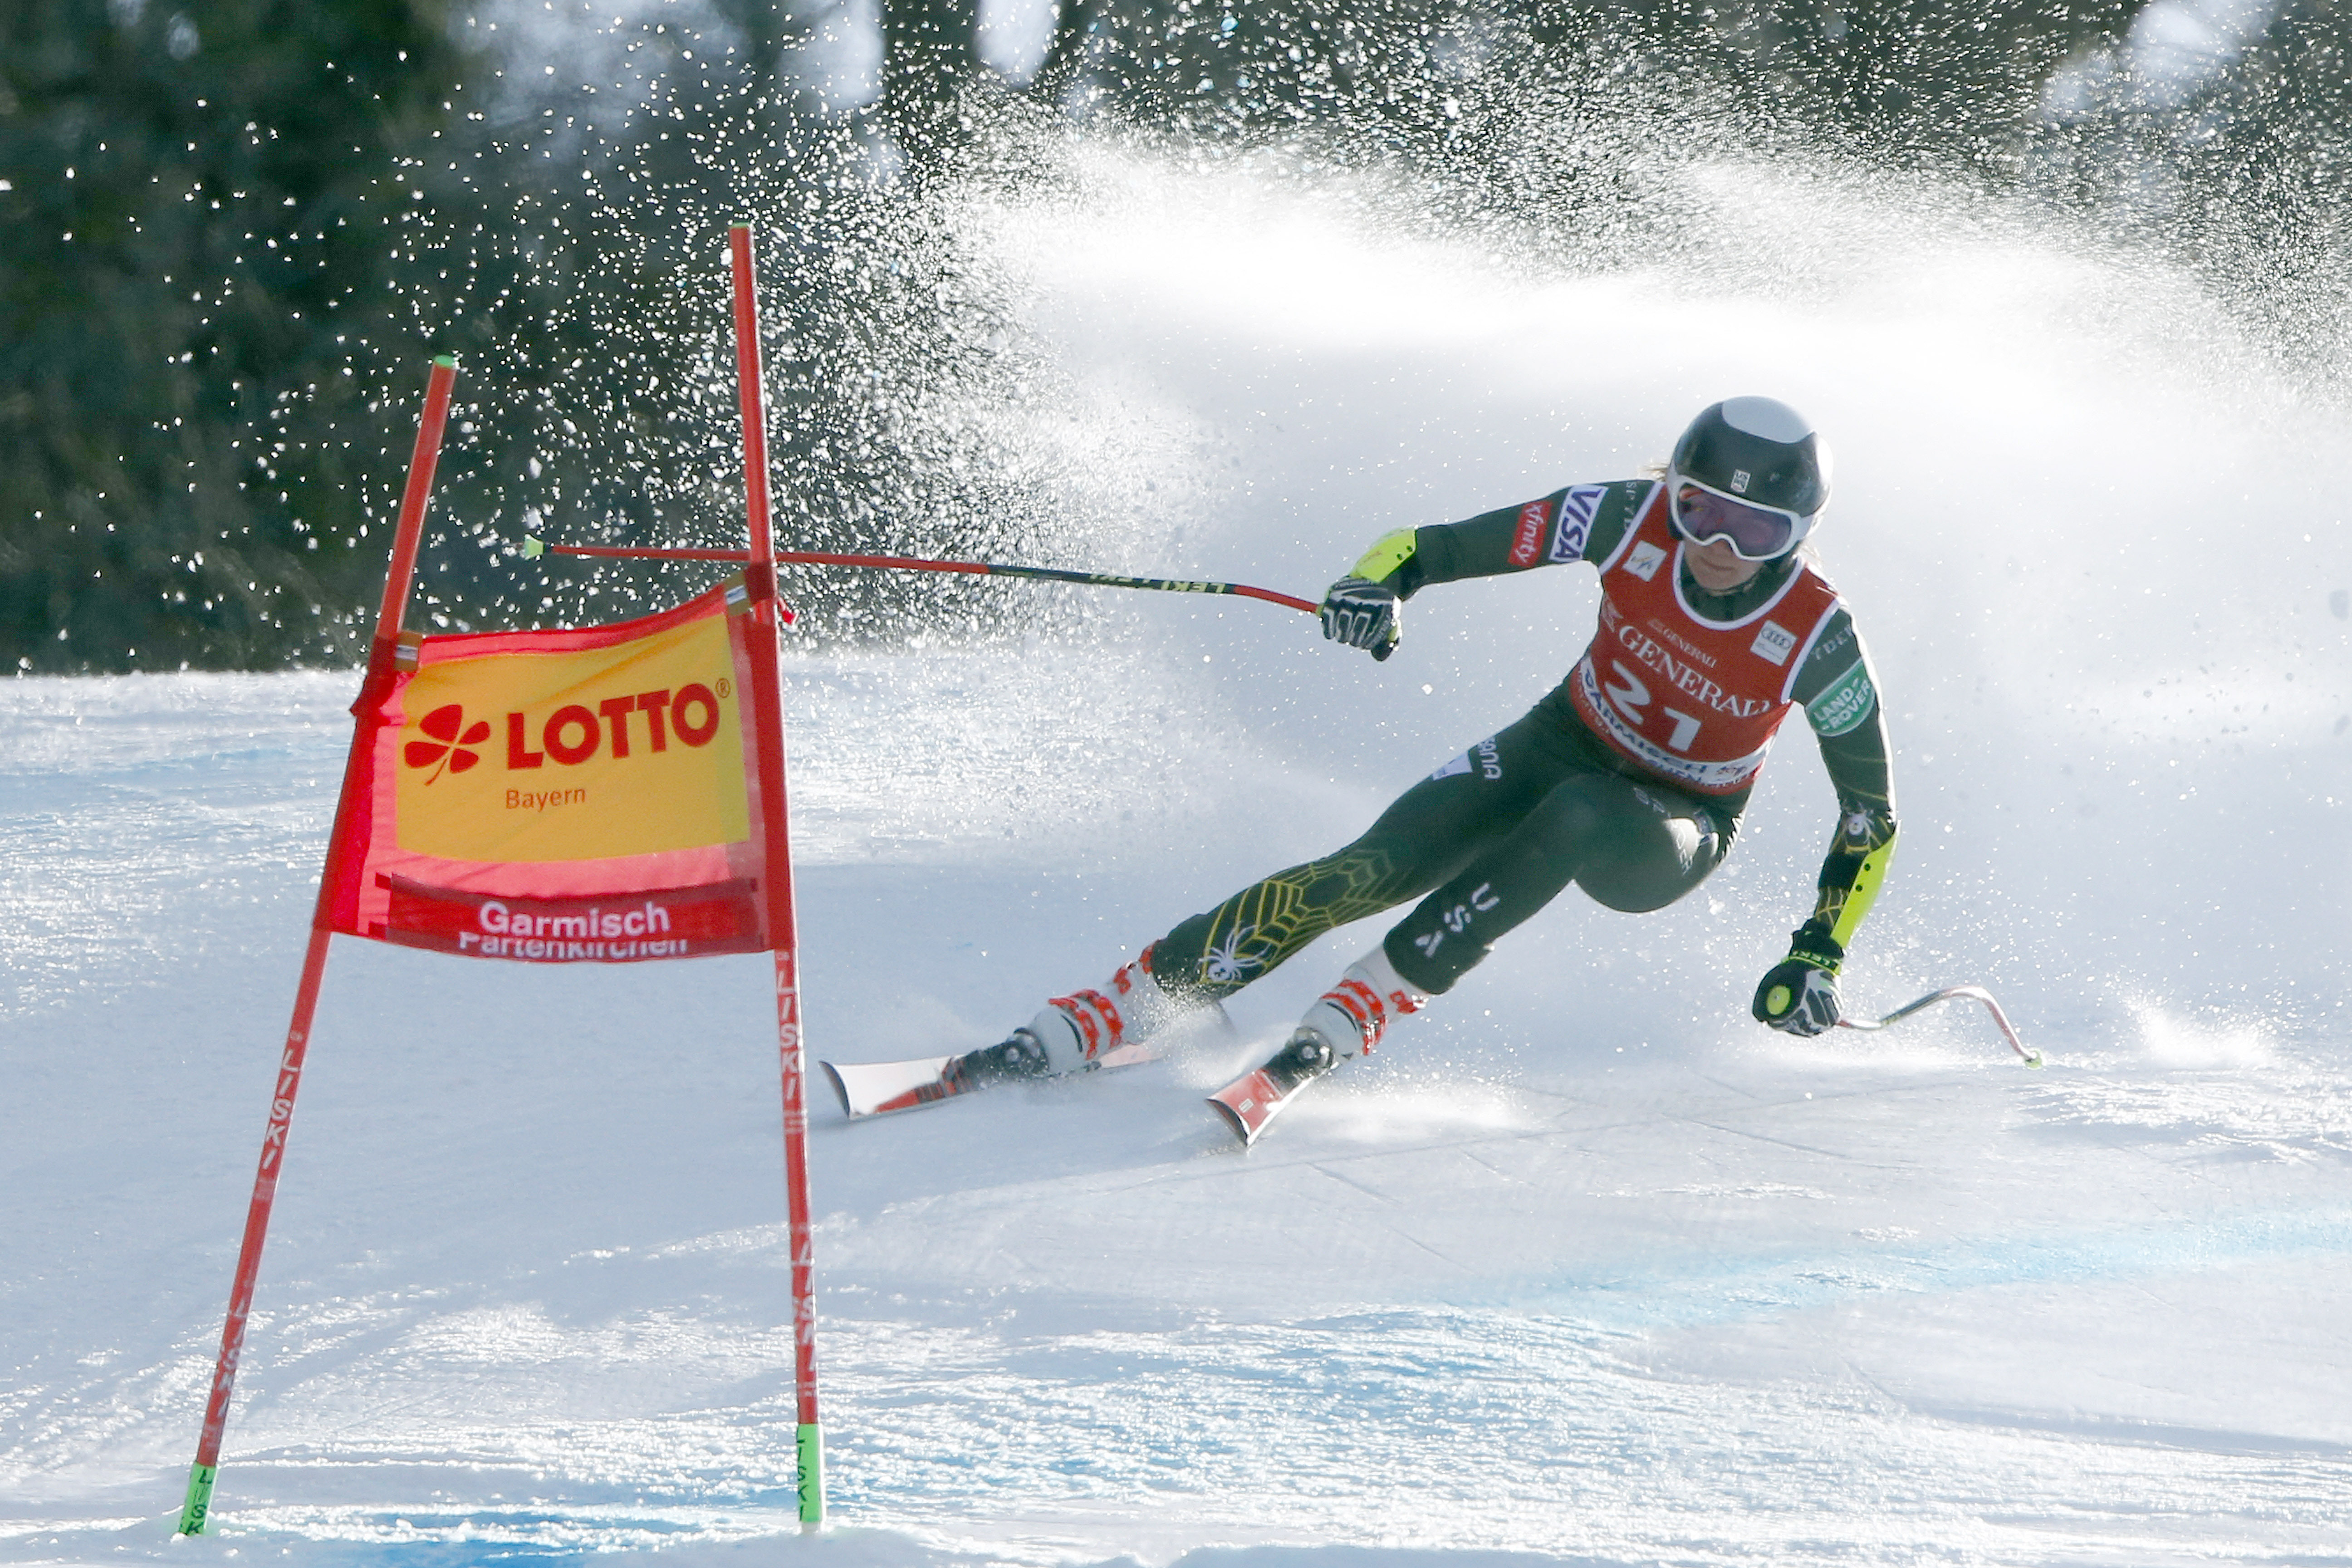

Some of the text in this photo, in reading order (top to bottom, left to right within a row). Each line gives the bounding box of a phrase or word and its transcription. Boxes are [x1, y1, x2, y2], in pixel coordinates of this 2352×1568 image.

[1555, 488, 1603, 558] VISA
[1161, 580, 1226, 593] LEKI
[1604, 659, 1702, 752] 21
[1813, 687, 1854, 717] LAND
[1829, 680, 1871, 729] ROVER
[506, 787, 586, 811] Bayern
[480, 901, 671, 938] Garmisch
[1414, 882, 1500, 958] USA
[777, 970, 800, 1101] LISKI
[262, 1049, 299, 1170] LISKI
